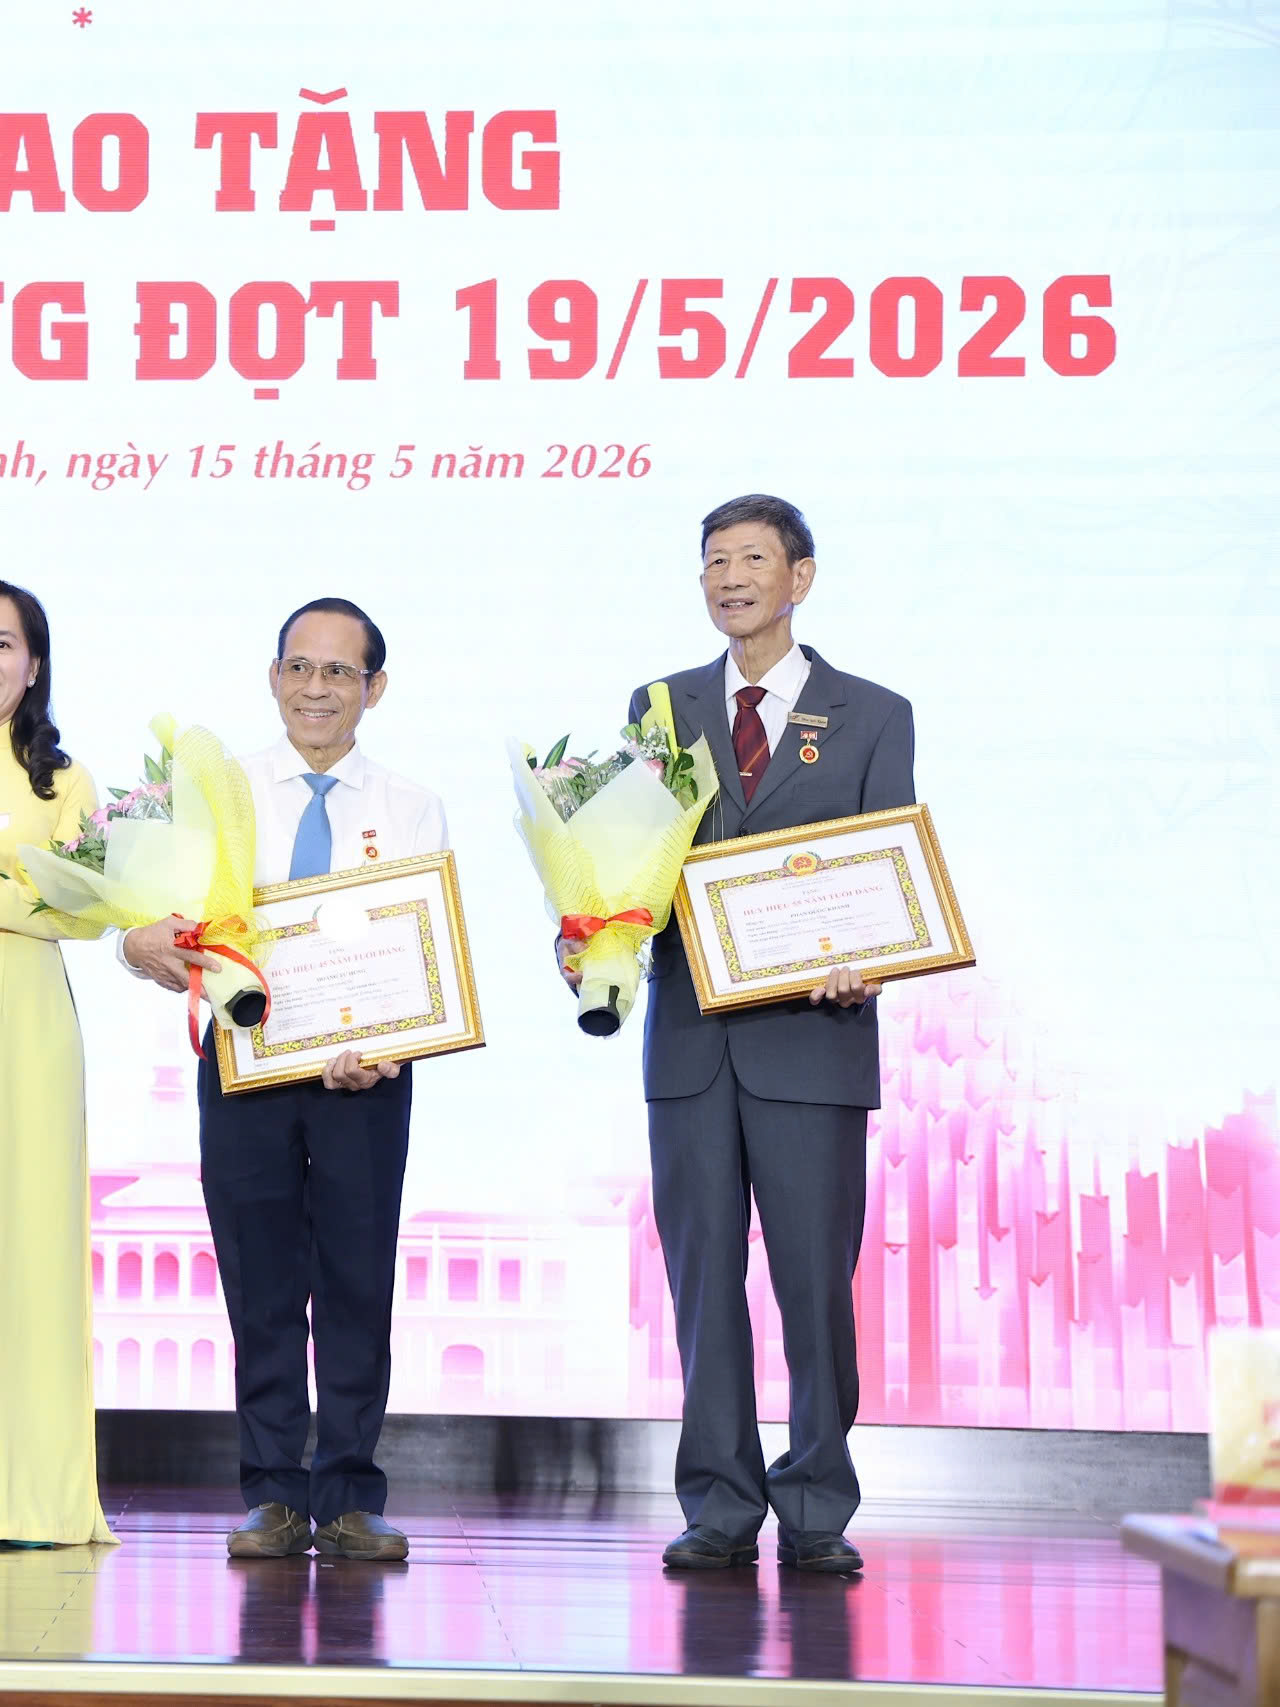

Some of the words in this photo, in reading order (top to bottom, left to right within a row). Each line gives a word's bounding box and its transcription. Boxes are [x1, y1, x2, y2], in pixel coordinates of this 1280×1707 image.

[194, 87, 561, 232] TẶNG
[133, 280, 400, 401] ĐỢT
[455, 275, 1117, 380] 19/5/2026
[66, 441, 167, 490] ngày
[189, 444, 236, 478] 15
[254, 440, 375, 490] tháng
[390, 444, 416, 478] 5
[431, 445, 525, 478] năm
[541, 444, 652, 478] 2026
